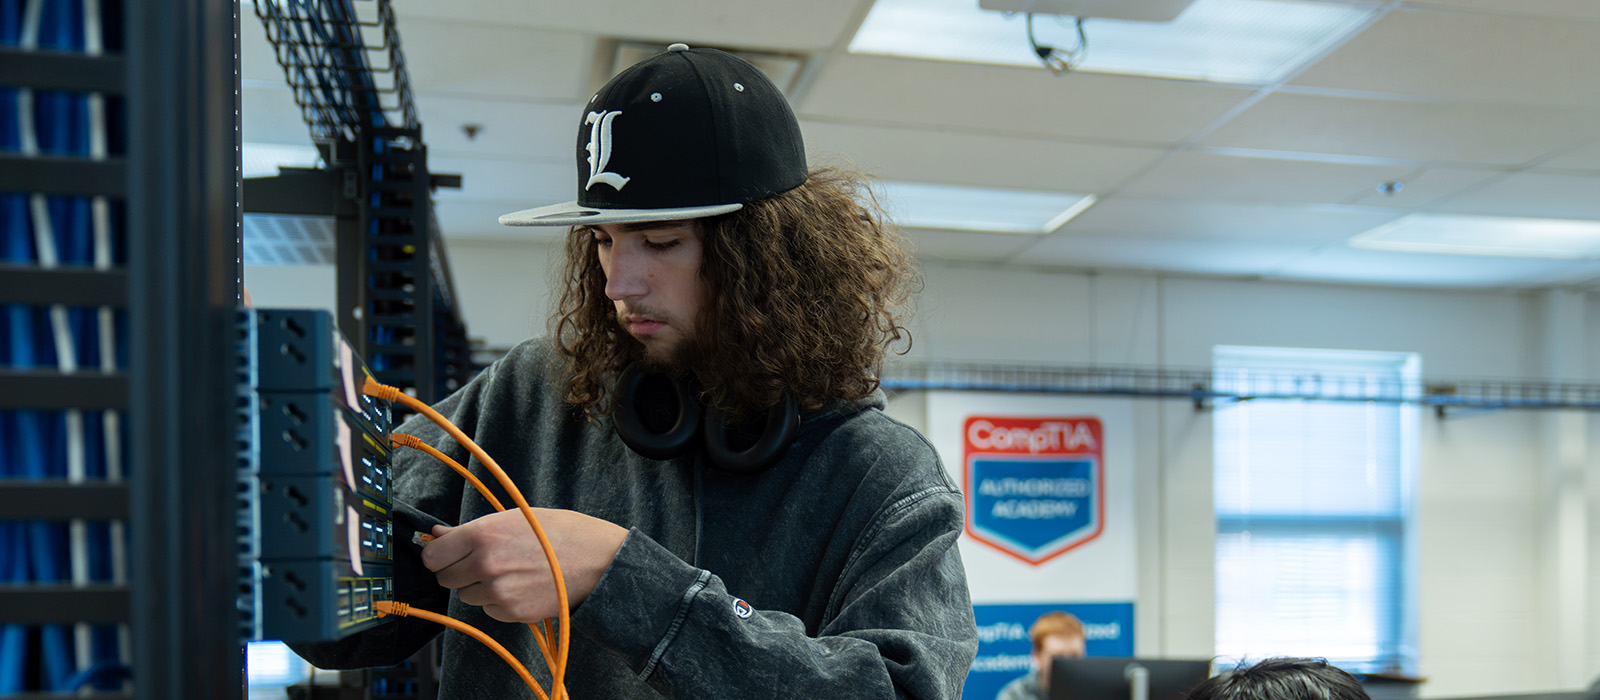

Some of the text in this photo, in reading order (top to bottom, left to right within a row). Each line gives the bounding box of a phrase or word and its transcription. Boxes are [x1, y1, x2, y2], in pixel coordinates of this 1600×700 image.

[585, 110, 631, 191] L
[968, 420, 1096, 453] CompTIA
[979, 478, 1089, 498] AUTHORIZED
[991, 501, 1078, 519] ACADEMY
